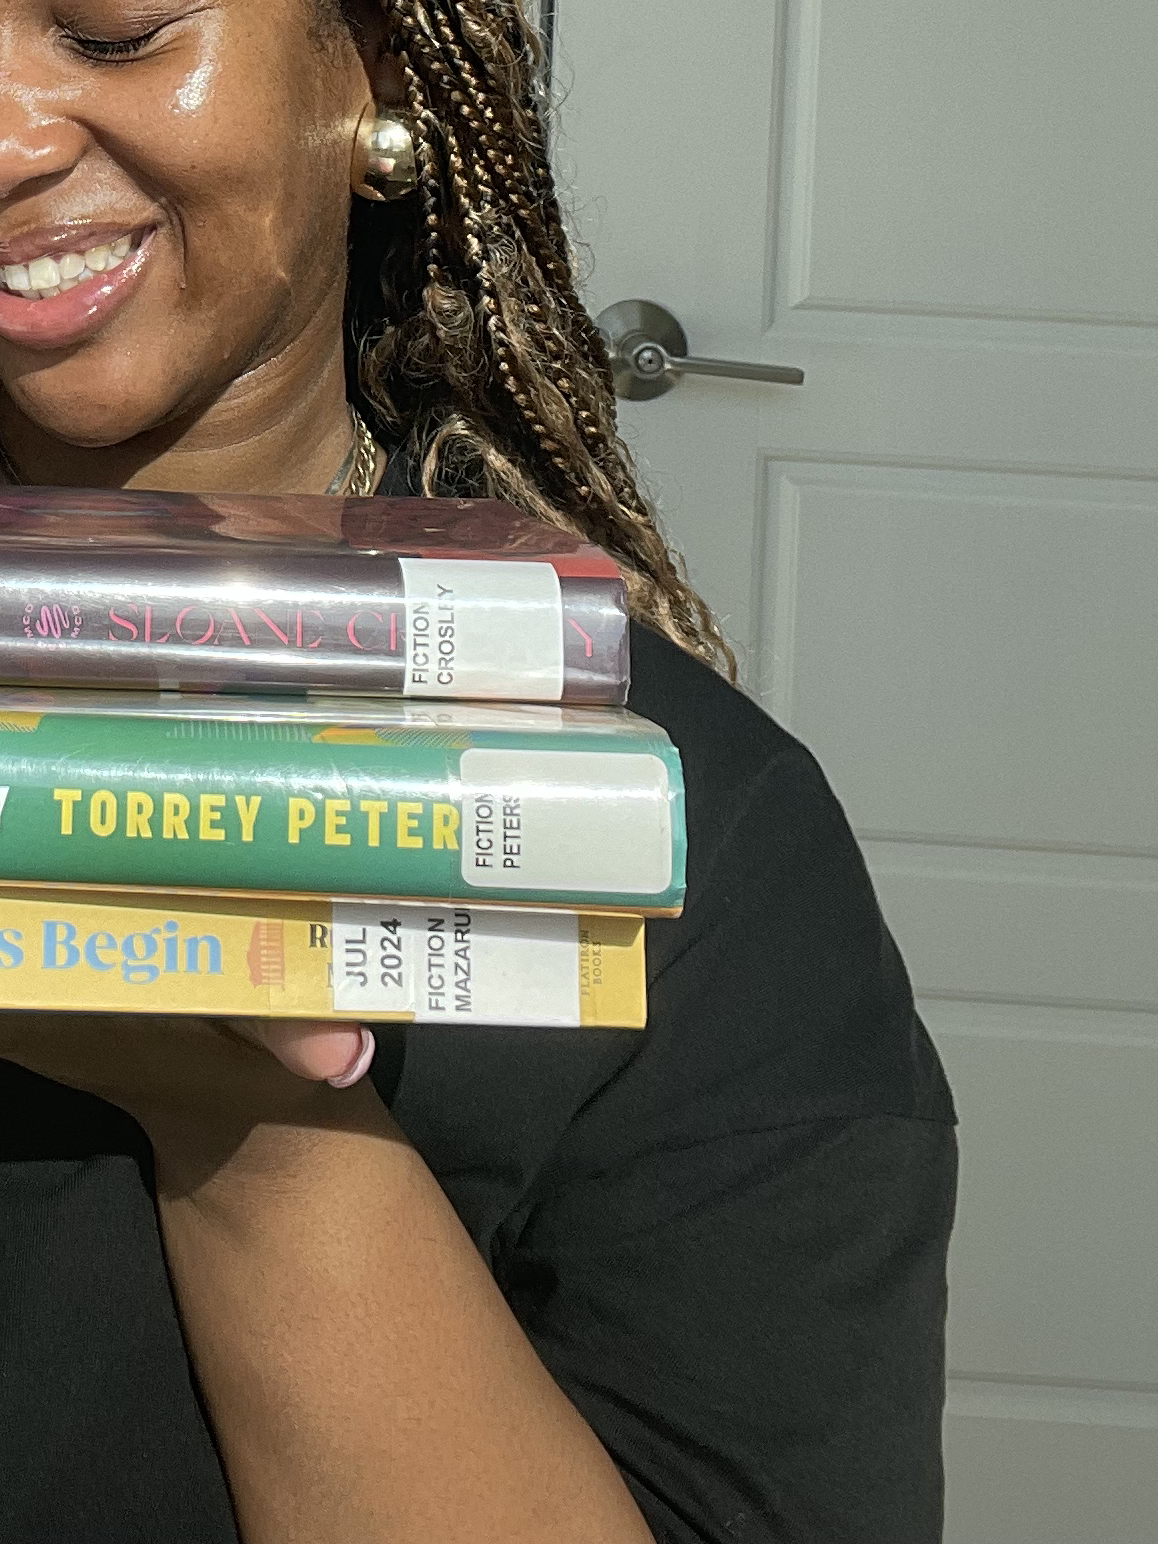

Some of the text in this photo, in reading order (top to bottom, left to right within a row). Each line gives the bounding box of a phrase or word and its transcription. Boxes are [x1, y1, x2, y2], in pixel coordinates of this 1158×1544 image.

[107, 602, 326, 649] SLOANE
[411, 602, 430, 685] FICTION
[436, 583, 456, 686] CROSLEY
[53, 787, 263, 844] TORREY
[474, 792, 494, 868] FICTION
[41, 919, 223, 986] Begin
[344, 927, 369, 988] JUL
[379, 917, 404, 988] 2024
[427, 917, 446, 1012] FICTION
[579, 928, 590, 997] FLATIRON
[592, 941, 603, 985] BOOKS
